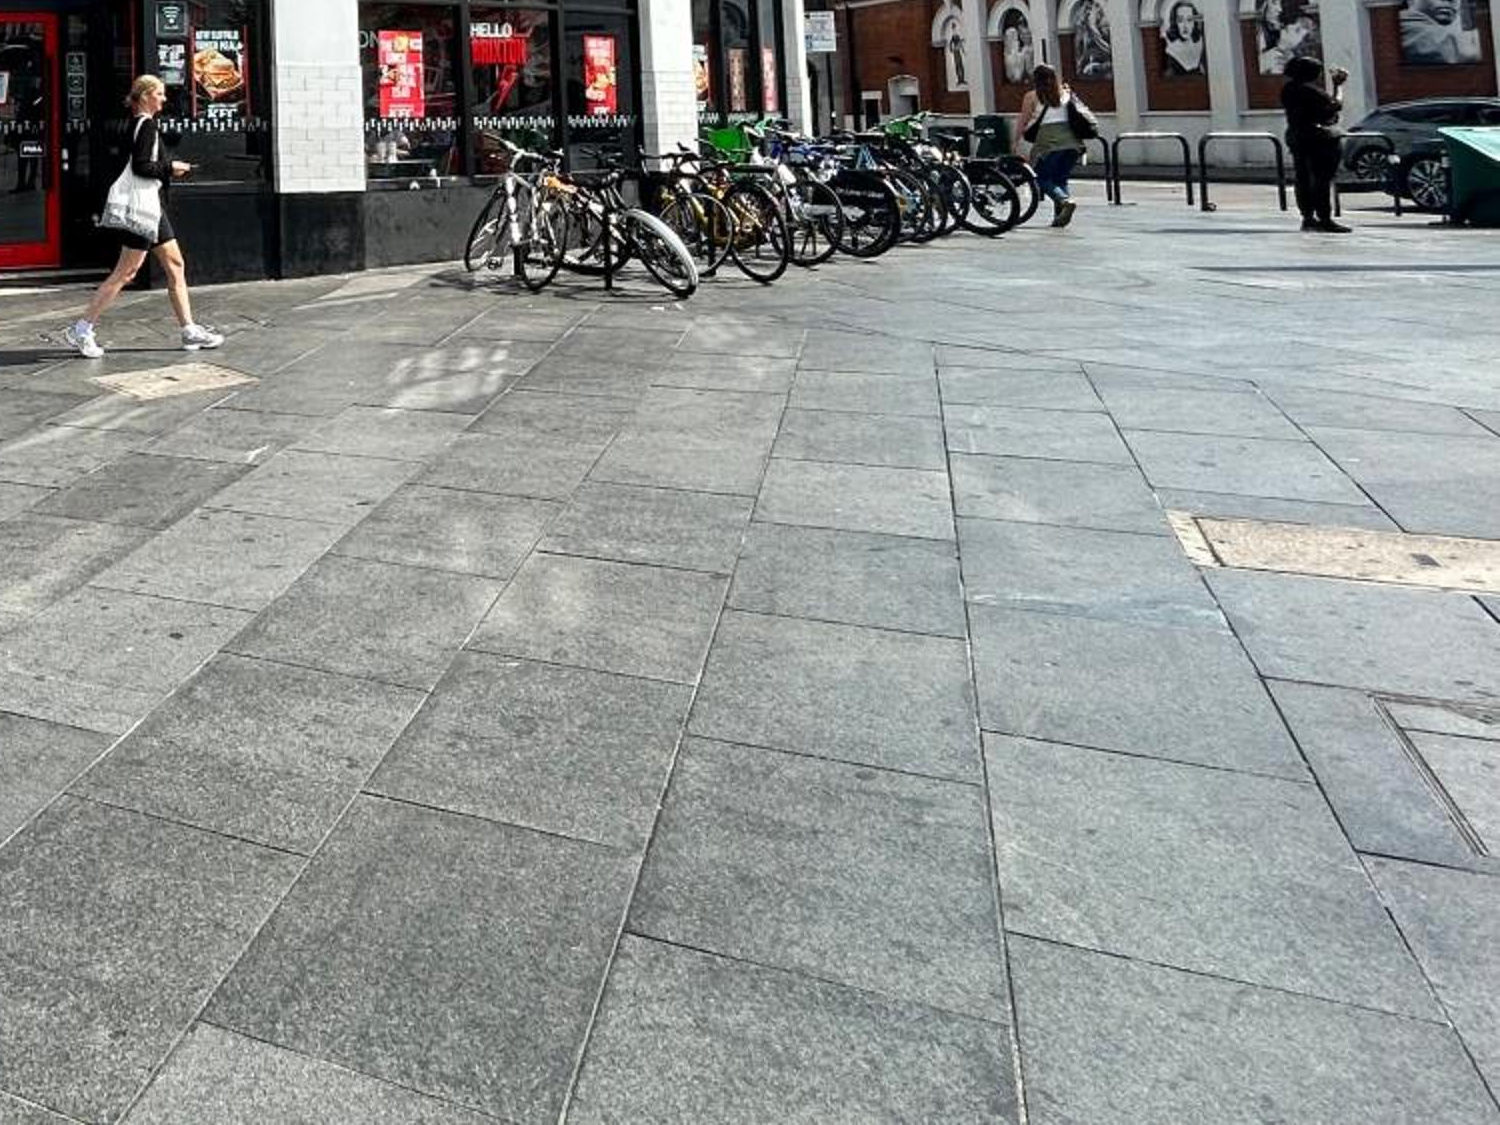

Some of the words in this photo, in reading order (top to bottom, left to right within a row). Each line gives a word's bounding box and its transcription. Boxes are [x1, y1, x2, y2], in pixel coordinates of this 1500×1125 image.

[470, 22, 513, 38] HELLO
[472, 38, 528, 65] BRIXTON
[208, 108, 238, 118] KFC
